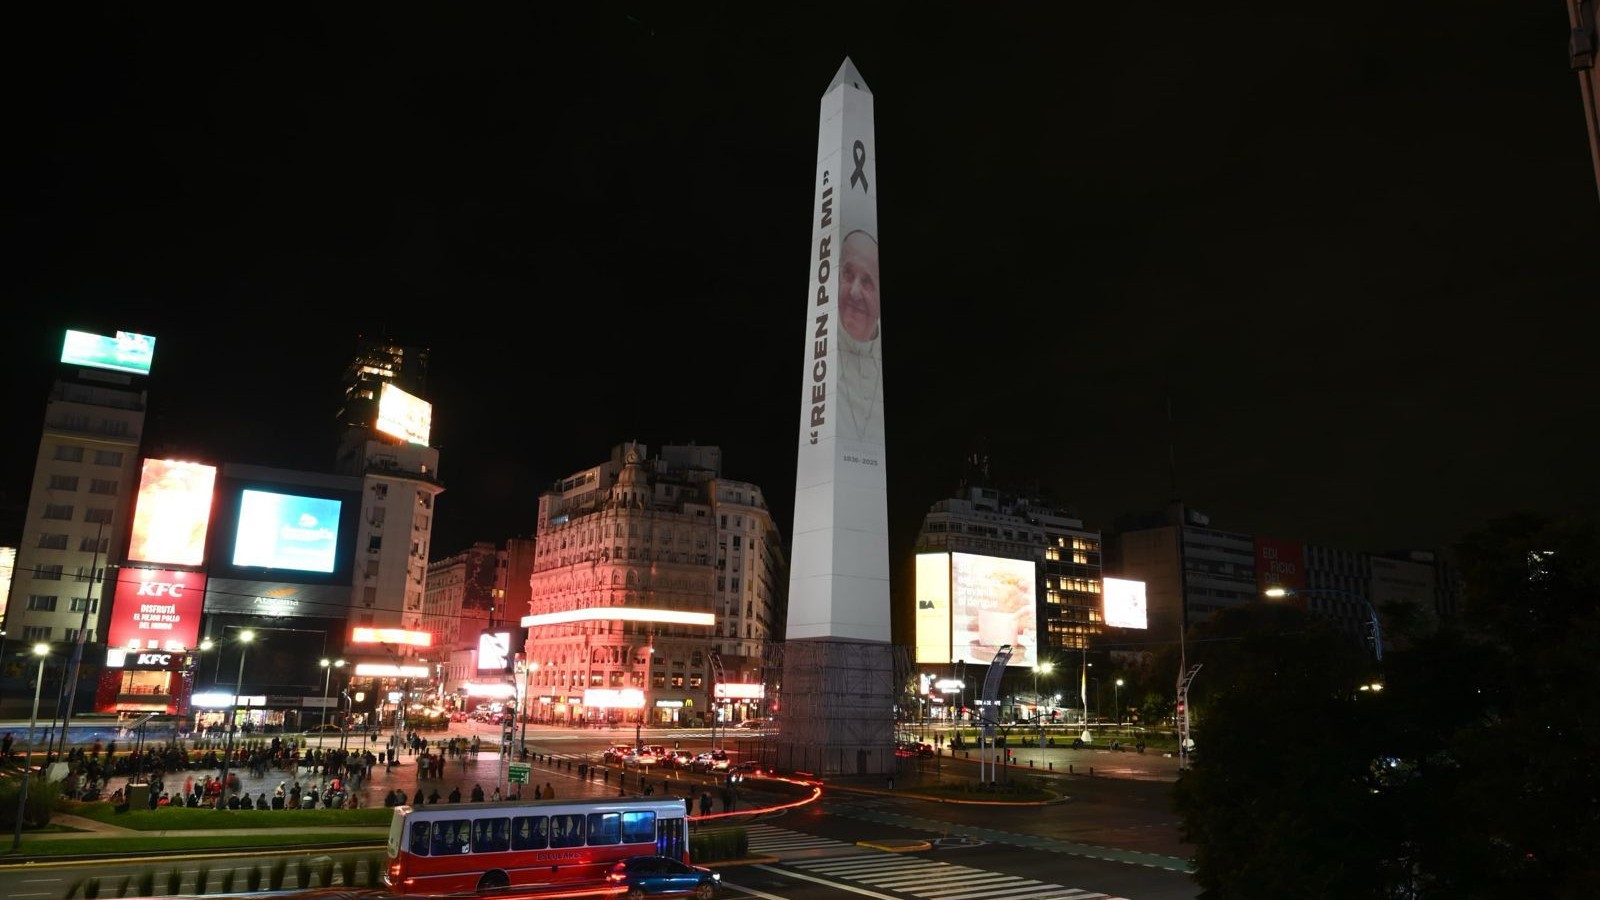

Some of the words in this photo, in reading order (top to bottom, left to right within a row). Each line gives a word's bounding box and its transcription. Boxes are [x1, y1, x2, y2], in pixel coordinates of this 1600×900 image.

[817, 234, 832, 306] POR
[137, 581, 186, 598] KFC
[919, 600, 935, 609] BA
[133, 613, 141, 621] EL
[161, 615, 181, 623] POLLO
[138, 621, 150, 630] DEL
[137, 654, 172, 666] KFC
